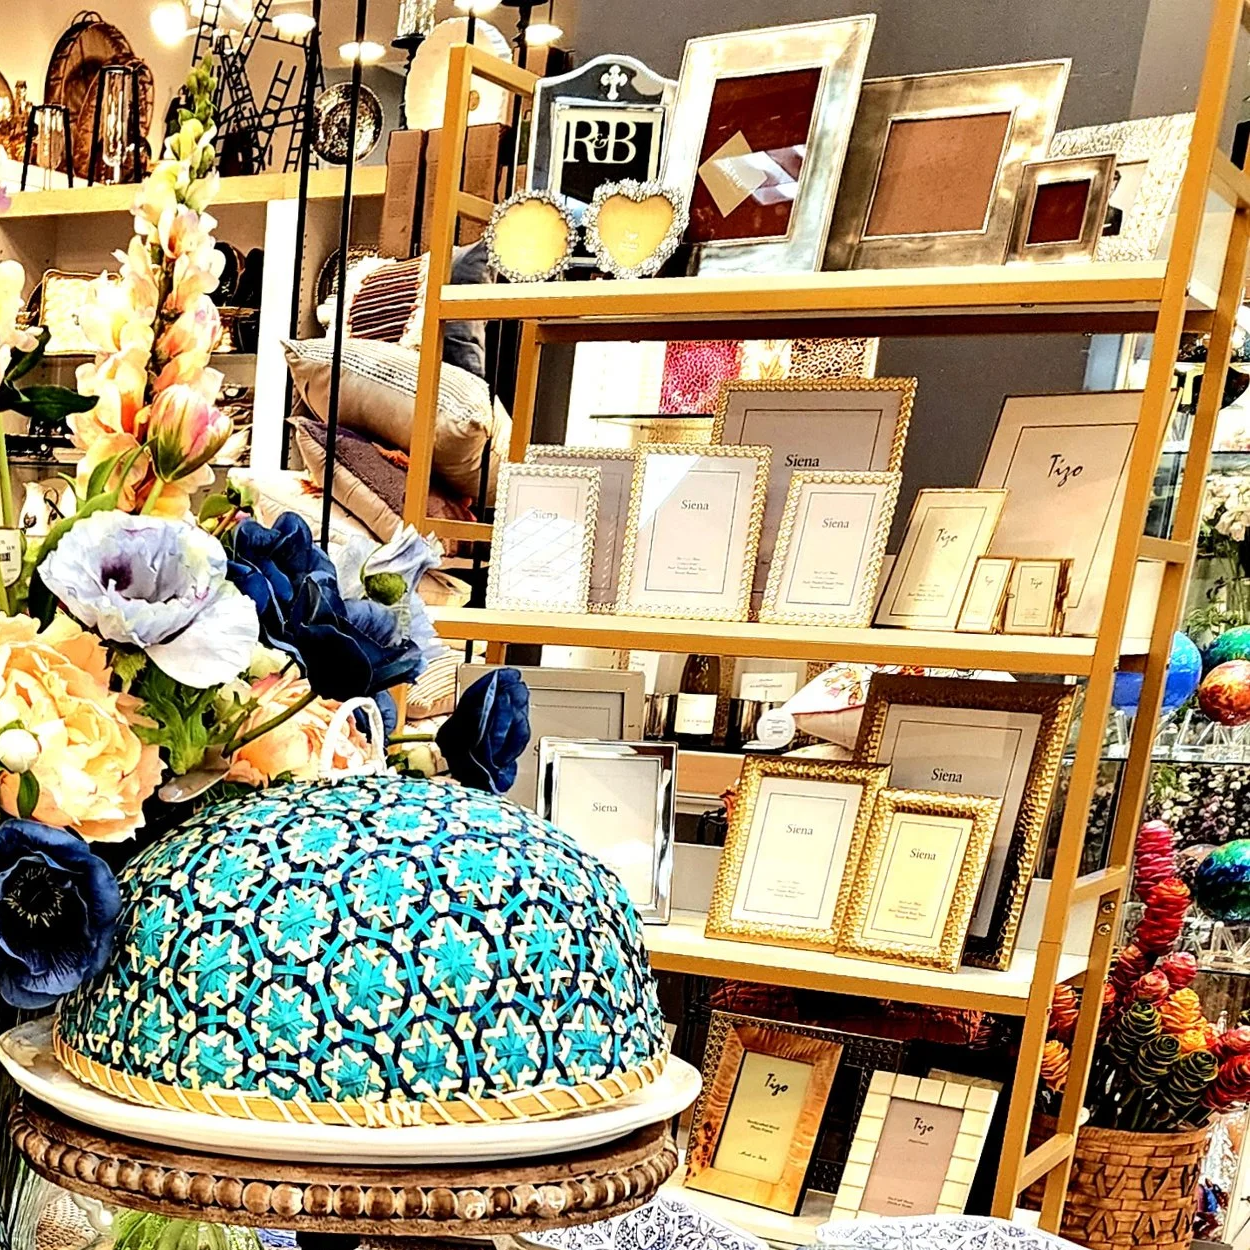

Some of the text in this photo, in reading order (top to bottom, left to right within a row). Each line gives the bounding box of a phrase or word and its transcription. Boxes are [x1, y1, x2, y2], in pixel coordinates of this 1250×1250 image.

[562, 119, 637, 164] R&B
[784, 453, 820, 467] Siena
[1047, 453, 1084, 488] Tizo
[680, 499, 710, 511] Siena
[821, 517, 850, 529] Siena
[935, 527, 958, 549] Tizo
[930, 767, 963, 783] Siena
[591, 801, 618, 813] Siena
[785, 823, 814, 836] Siena
[909, 847, 937, 861] Siena
[764, 1072, 789, 1097] Tizo
[913, 1116, 935, 1136] Tizo
